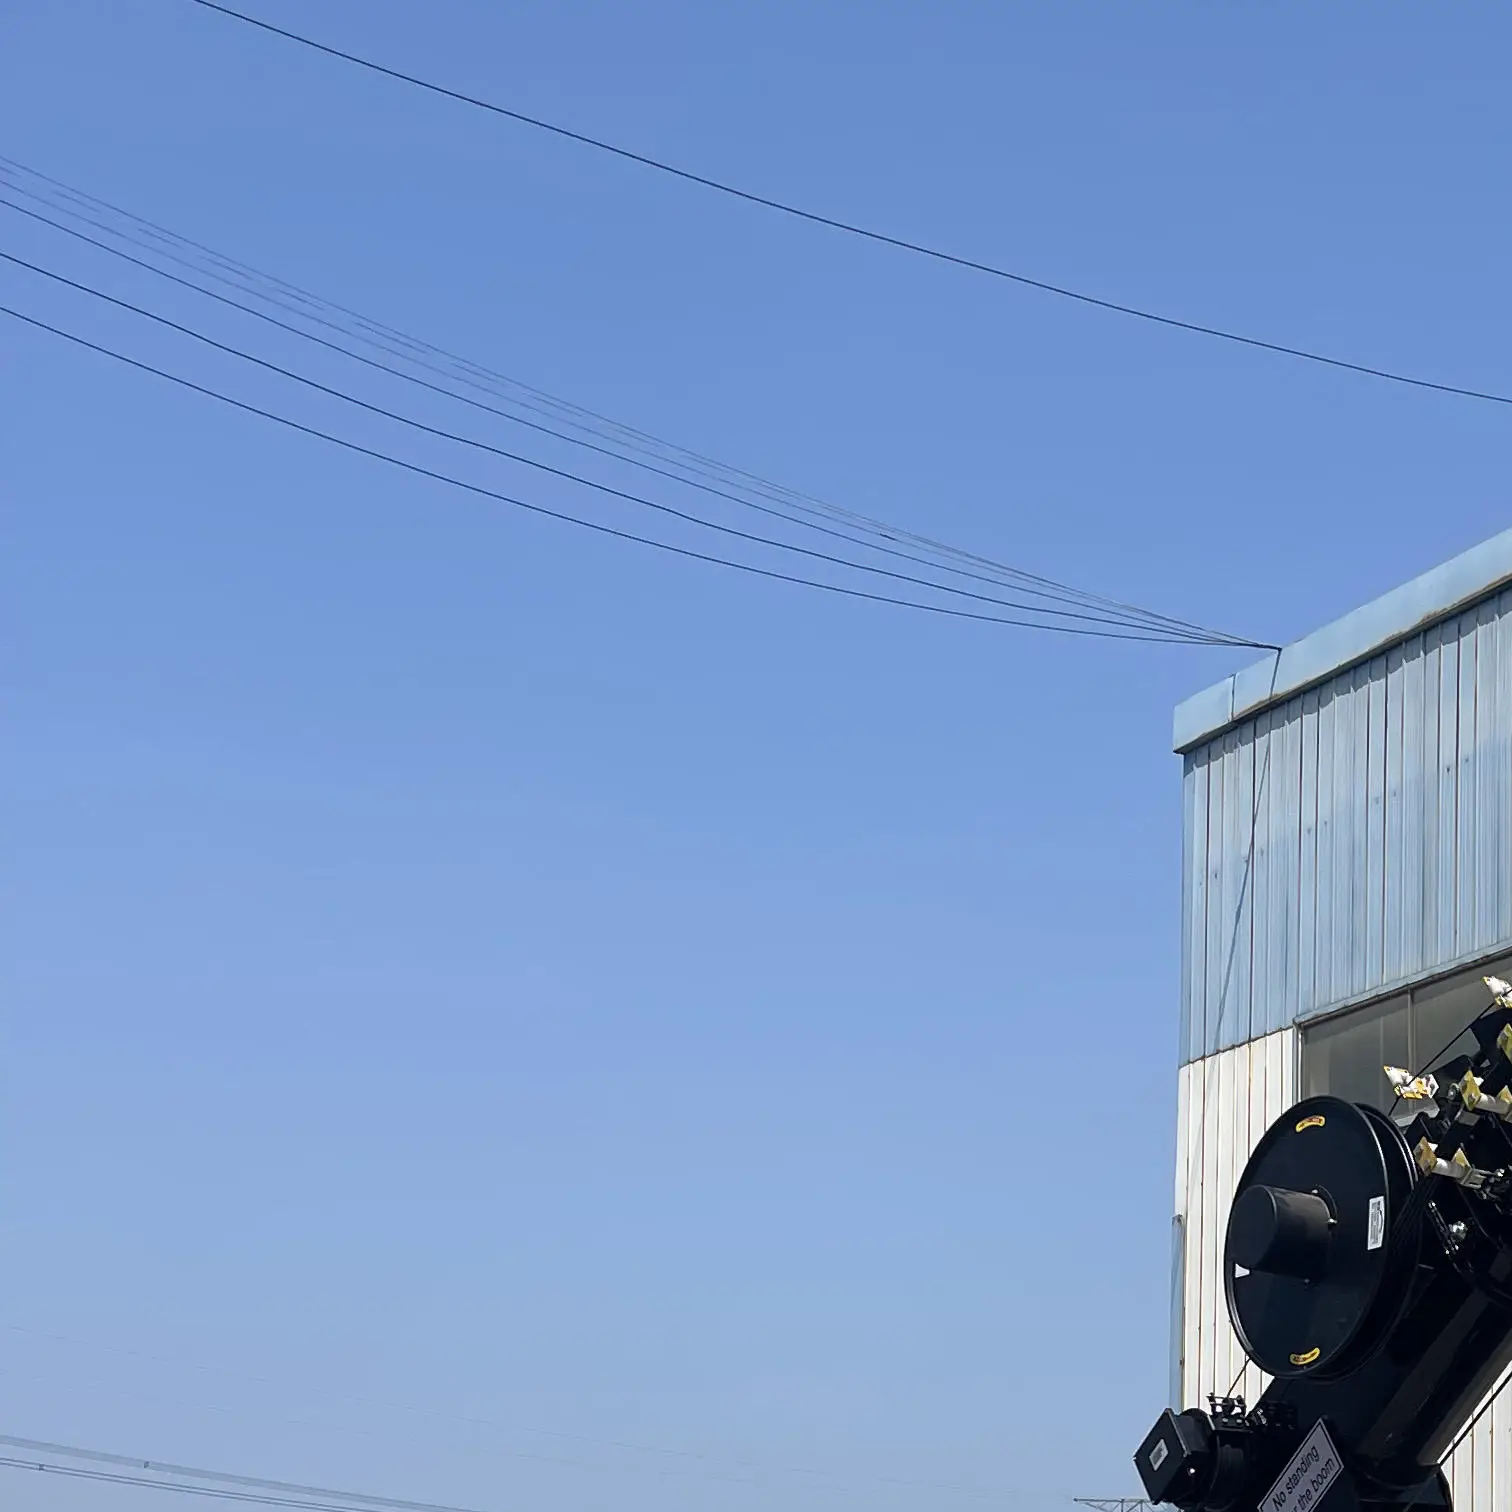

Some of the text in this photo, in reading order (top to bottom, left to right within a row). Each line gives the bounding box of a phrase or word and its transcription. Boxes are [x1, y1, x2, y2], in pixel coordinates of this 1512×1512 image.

[1271, 1445, 1321, 1512] No standing
[1297, 1488, 1313, 1510] the
[1310, 1457, 1336, 1493] boom
